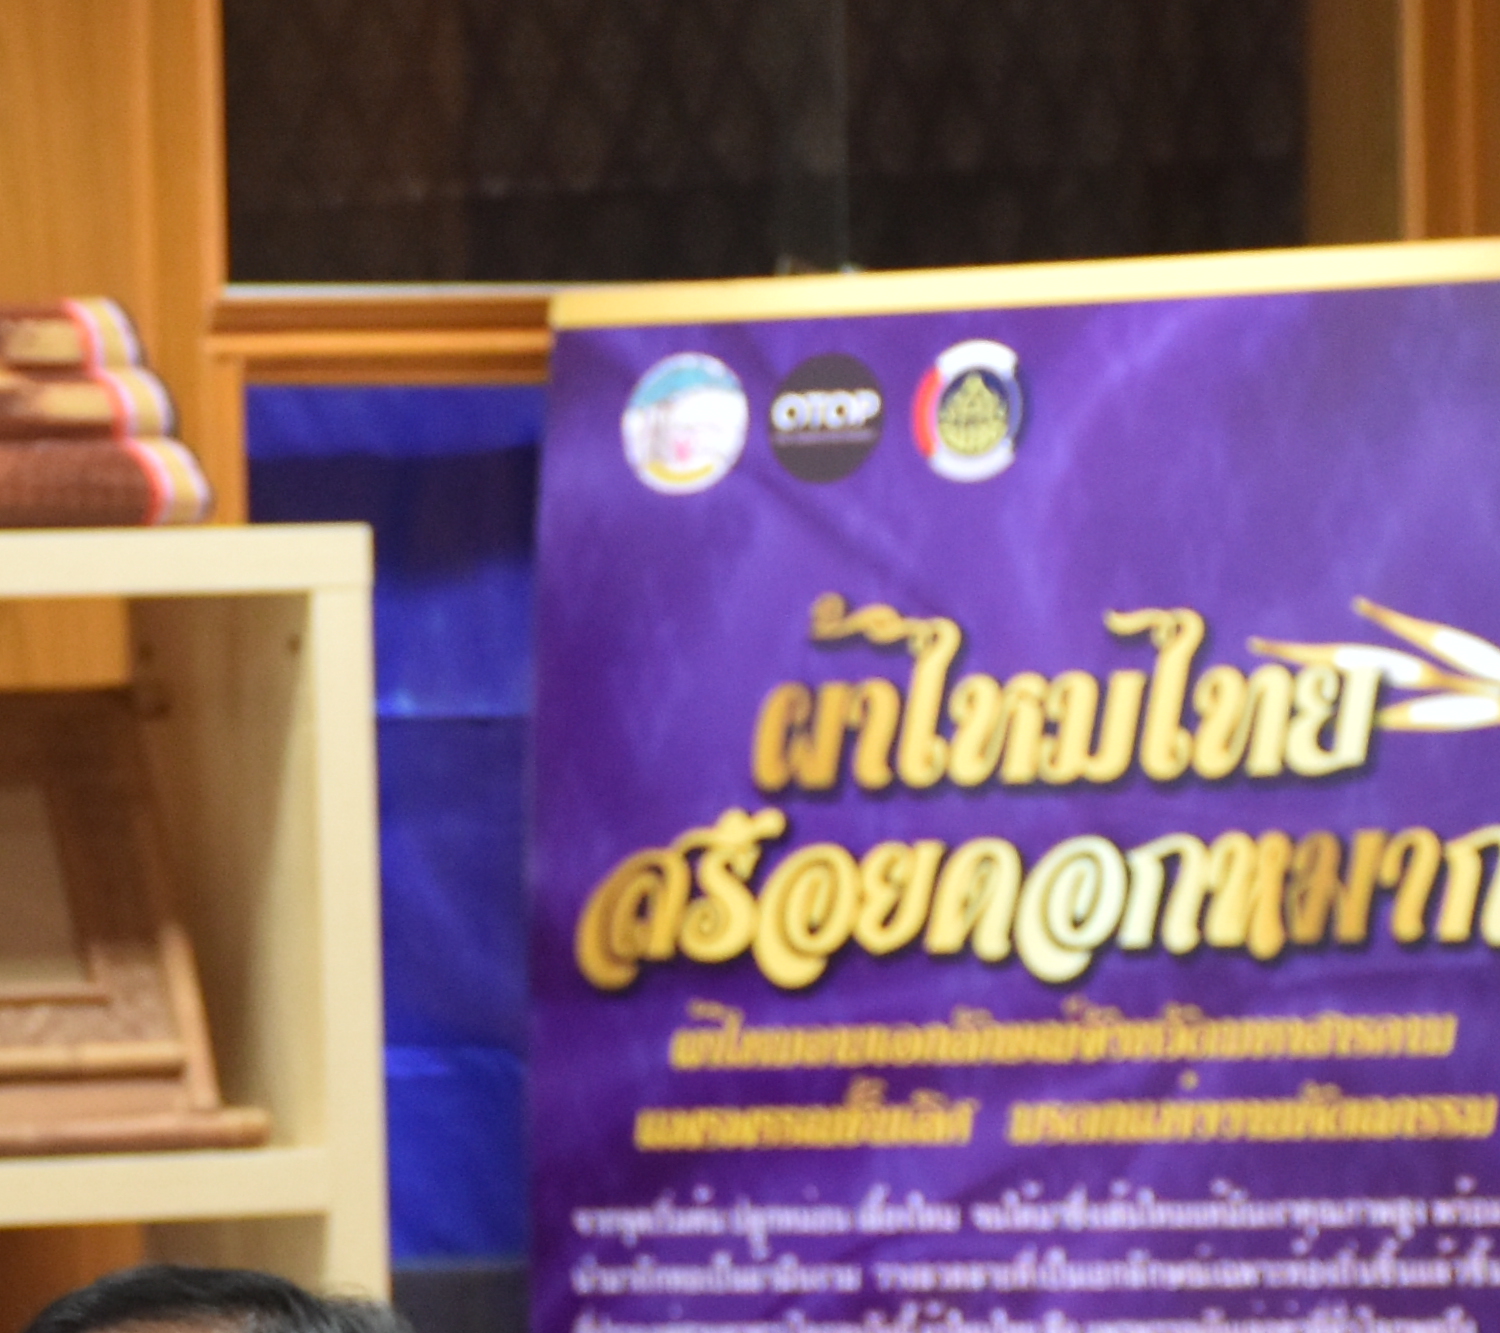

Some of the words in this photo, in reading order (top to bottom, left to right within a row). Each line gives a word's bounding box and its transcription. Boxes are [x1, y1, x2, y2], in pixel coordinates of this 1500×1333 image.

[771, 388, 882, 432] OTOP
[752, 591, 1390, 794] ผ้าไหมไทย
